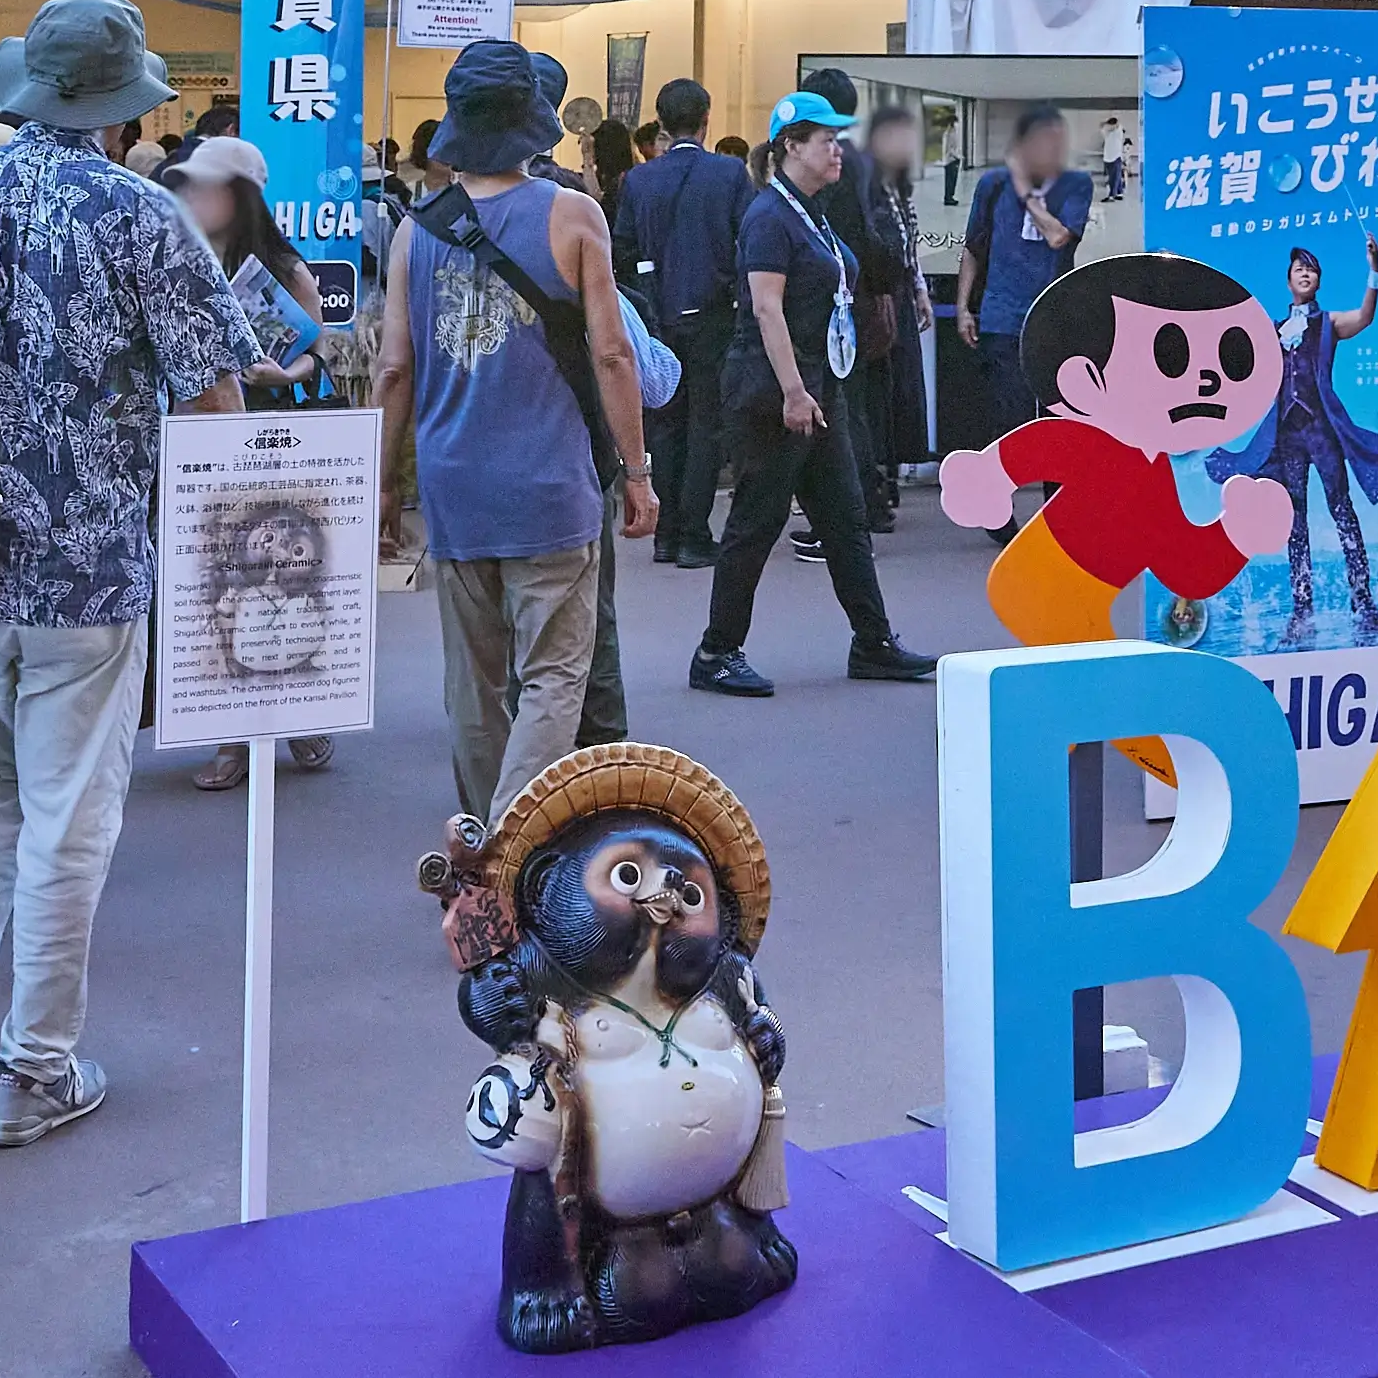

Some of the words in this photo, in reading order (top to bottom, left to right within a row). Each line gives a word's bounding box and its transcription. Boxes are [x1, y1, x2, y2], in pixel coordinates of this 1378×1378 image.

[434, 15, 478, 24] Attention!
[275, 200, 358, 239] HIGA
[330, 633, 345, 641] that
[242, 655, 254, 663] the
[333, 647, 348, 655] and
[354, 646, 361, 654] is
[232, 686, 246, 694] The
[248, 683, 284, 693] charming
[285, 680, 315, 689] raccoon
[317, 679, 331, 688] dog
[198, 702, 231, 713] depicted
[245, 700, 258, 708] the
[259, 698, 278, 707] front
[280, 697, 288, 705] of
[289, 696, 302, 704] the
